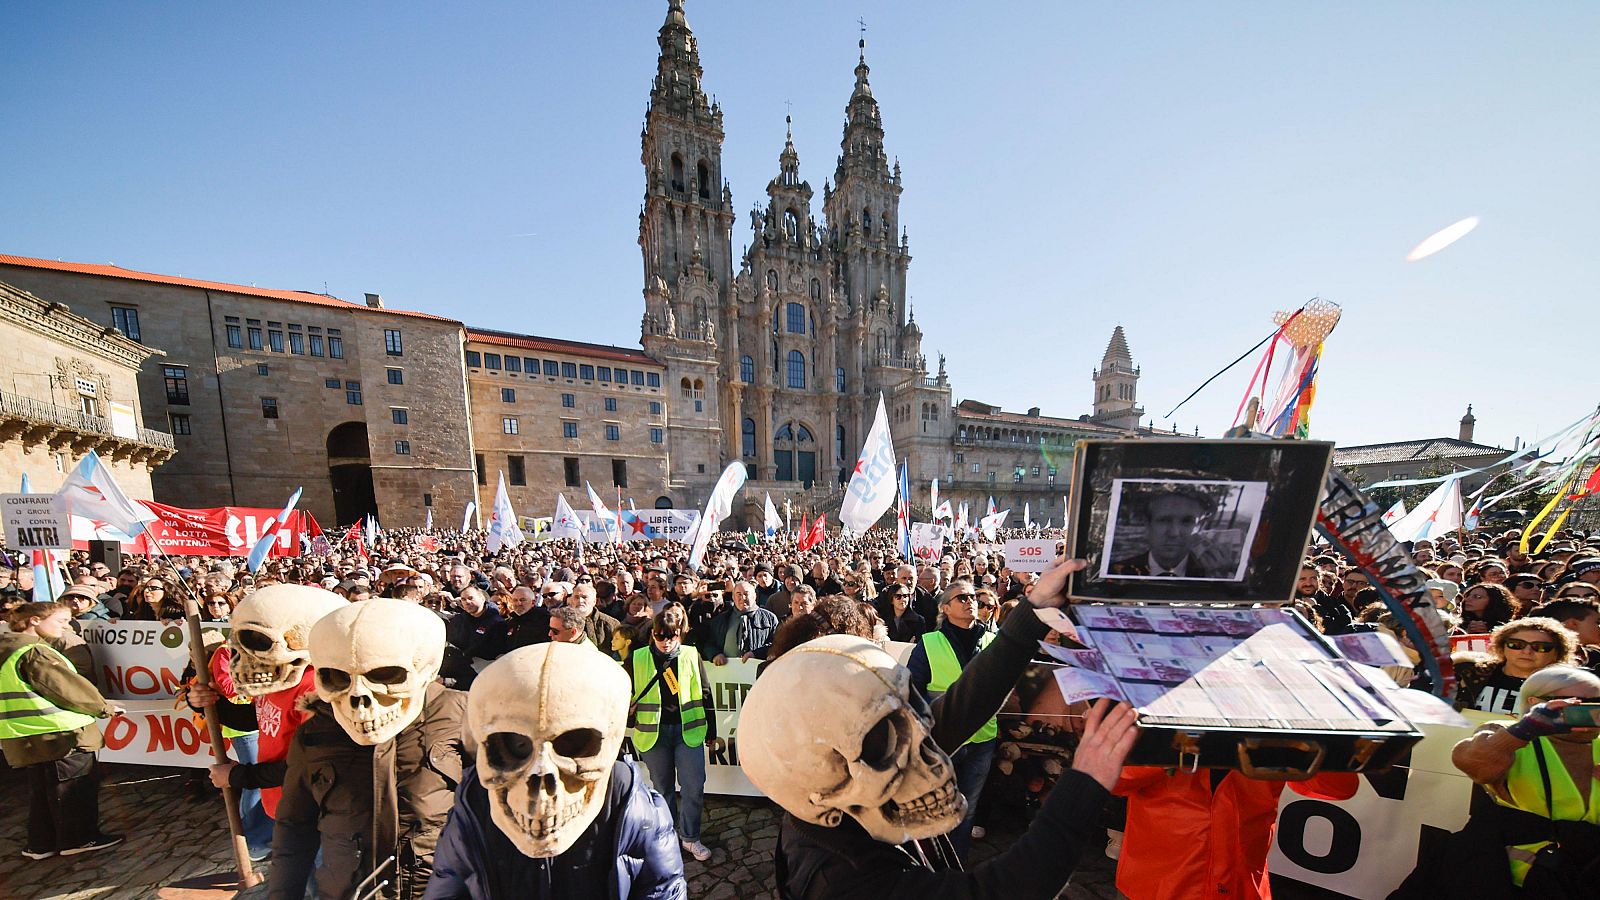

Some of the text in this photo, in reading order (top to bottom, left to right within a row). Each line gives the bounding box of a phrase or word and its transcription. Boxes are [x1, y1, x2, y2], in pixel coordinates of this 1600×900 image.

[18, 527, 59, 546] ALTRI
[176, 530, 208, 538] LOITA
[1019, 547, 1042, 556] SOS
[83, 626, 127, 645] CIÑOS
[132, 630, 156, 645] DE
[708, 728, 741, 766] RÍ
